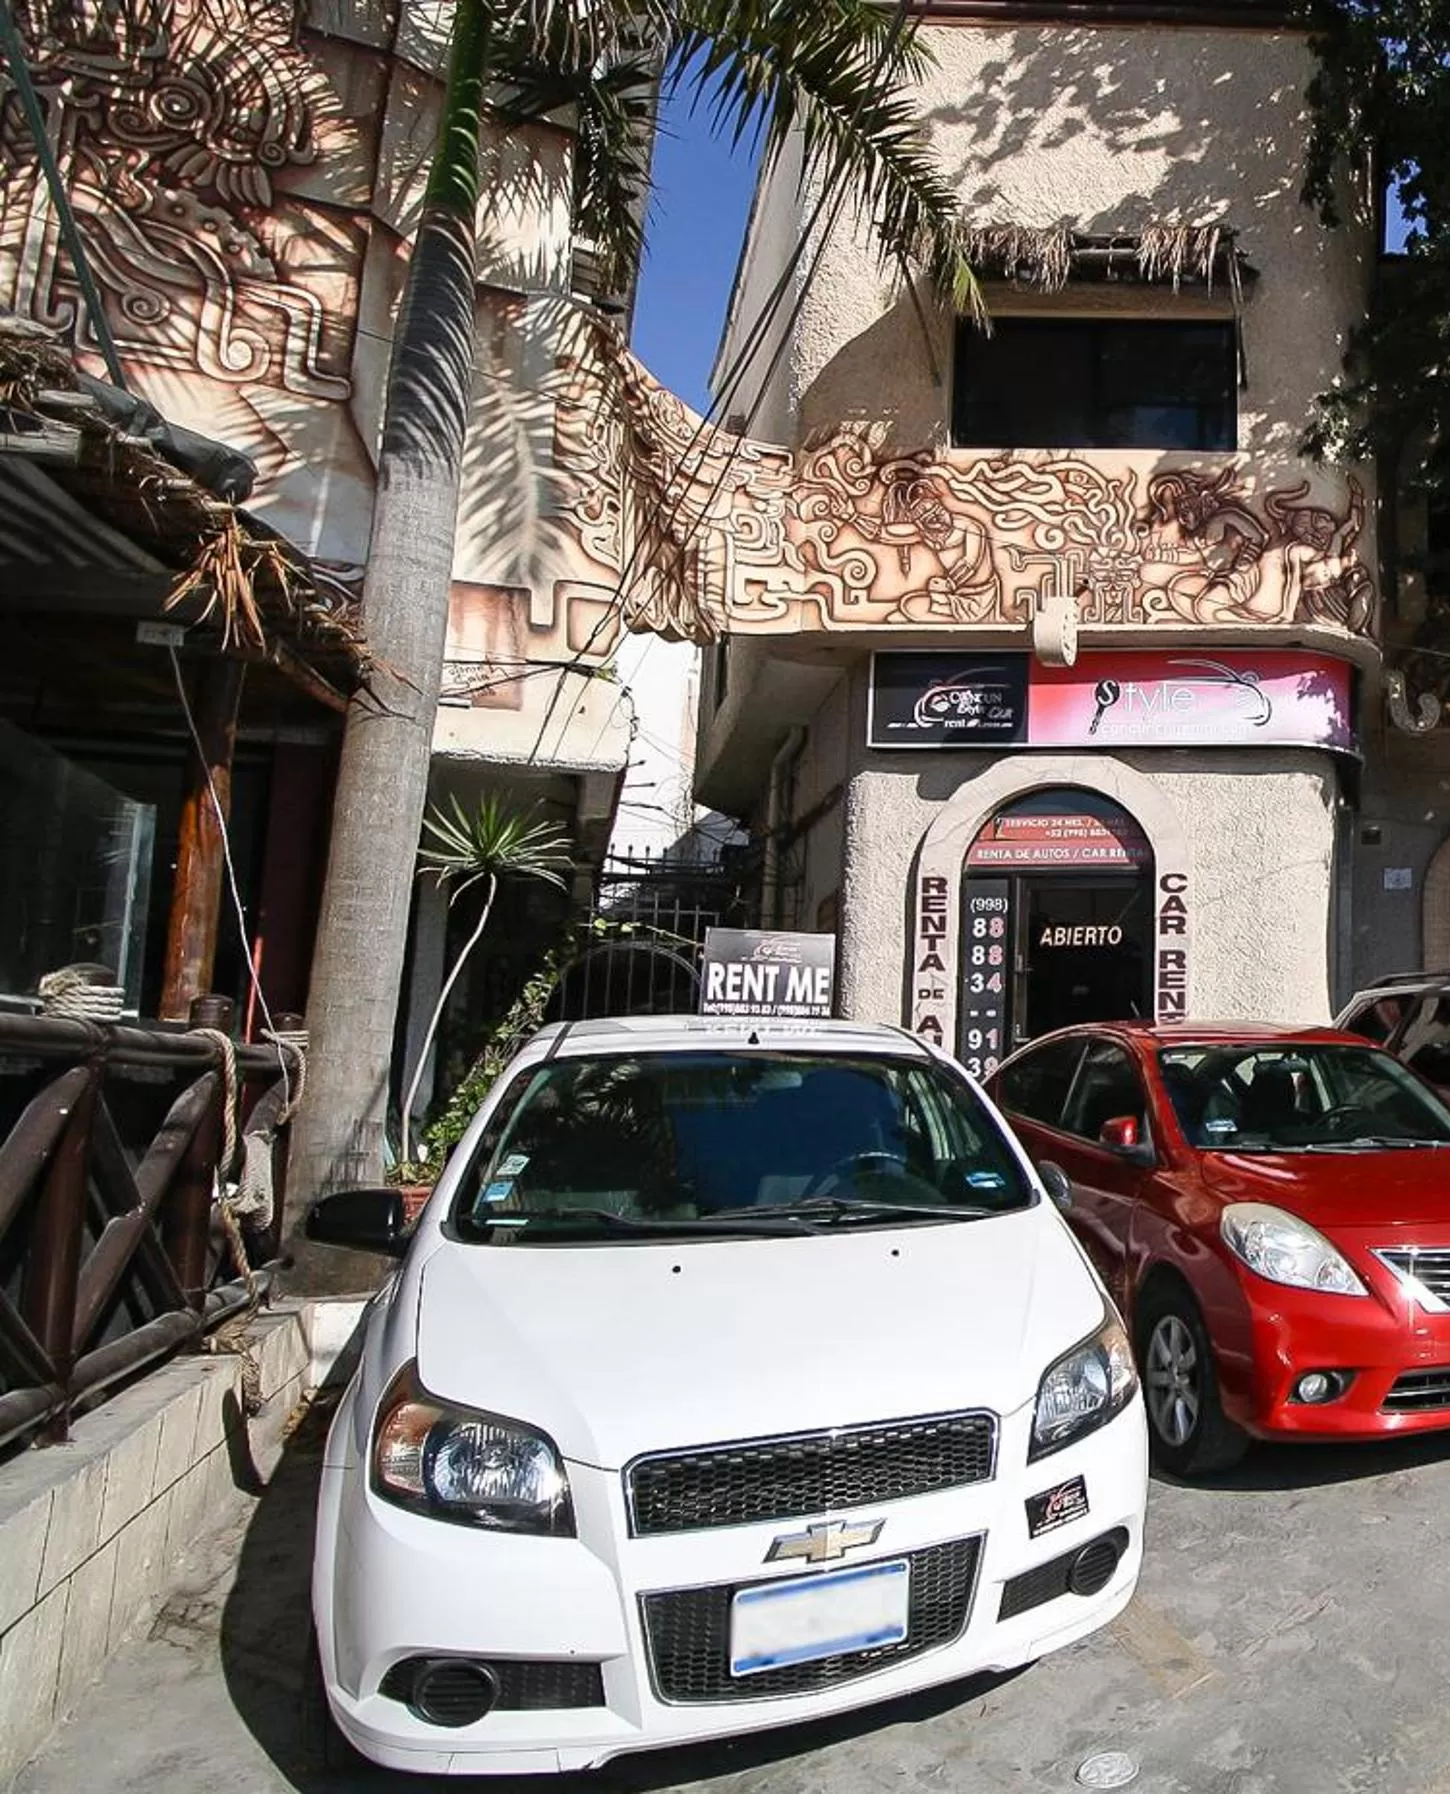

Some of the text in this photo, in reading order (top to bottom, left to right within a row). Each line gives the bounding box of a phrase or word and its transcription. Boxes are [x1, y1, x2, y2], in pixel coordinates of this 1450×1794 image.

[1096, 679, 1194, 714] Style
[977, 850, 1013, 860] RENTA
[1015, 850, 1030, 860] DE
[1033, 849, 1070, 859] AUTOS
[1082, 848, 1108, 858] CAR
[970, 898, 1008, 914] (998)
[1159, 874, 1188, 934] CAR
[919, 877, 948, 972] RENTA
[1040, 926, 1123, 946] ABIERTO
[707, 961, 830, 1004] RENT ME
